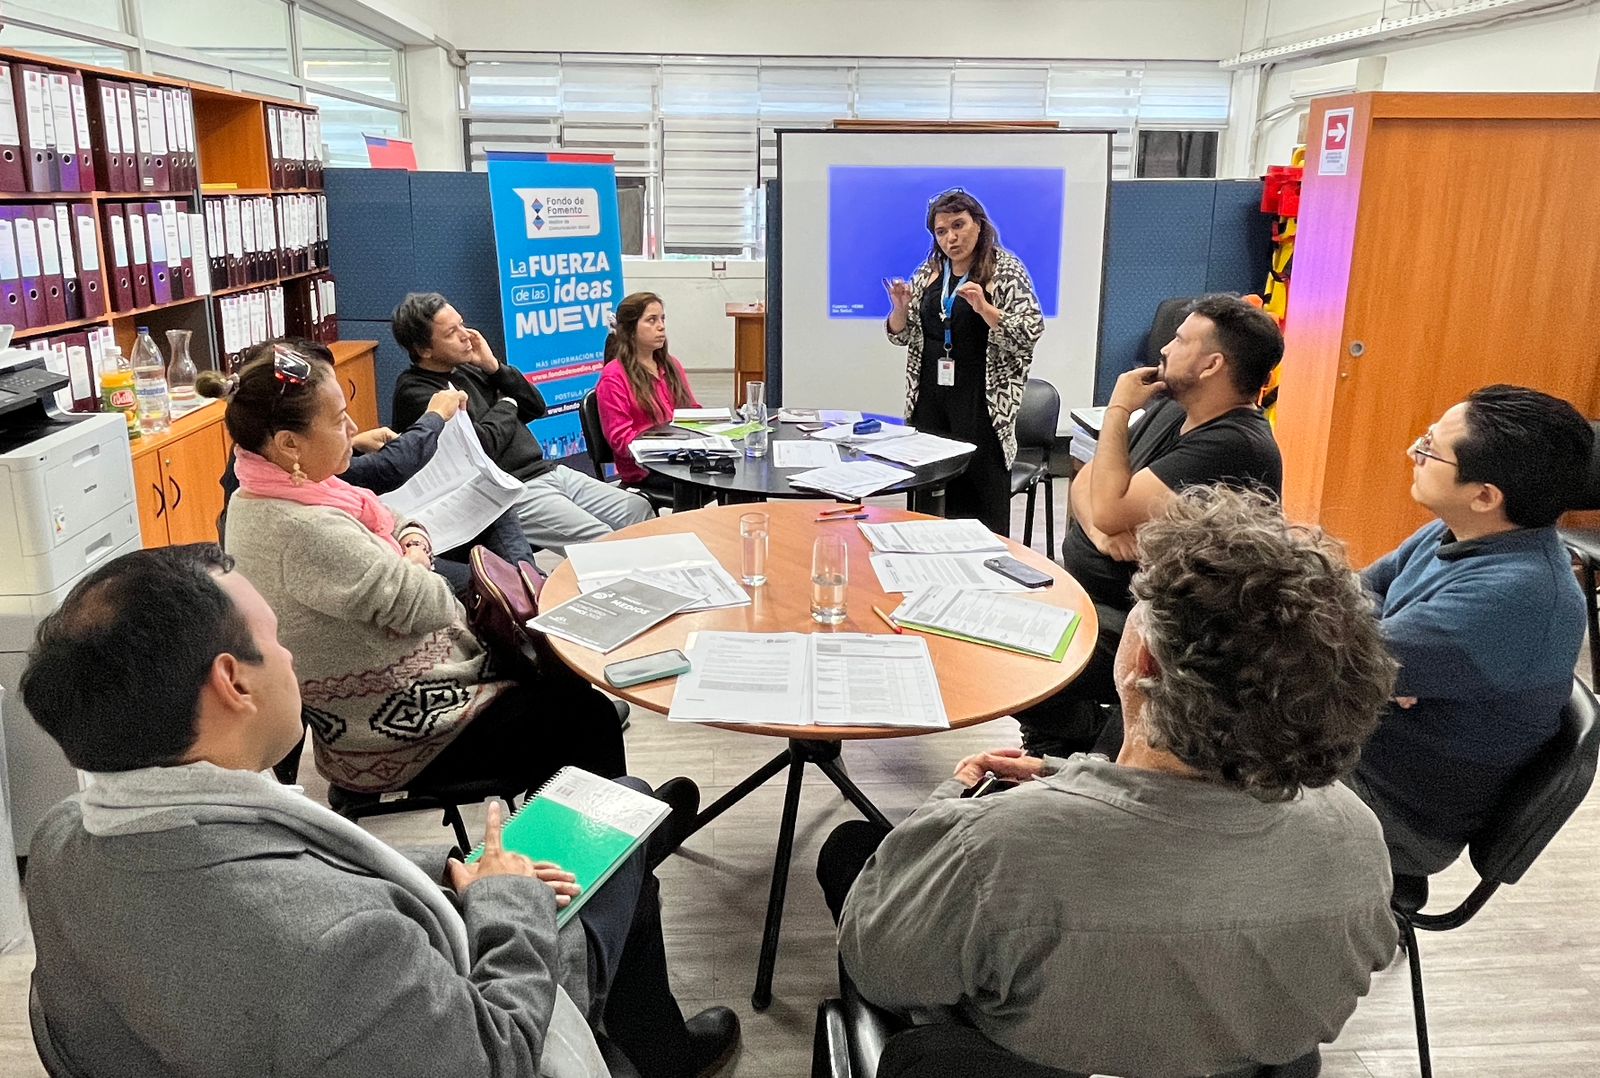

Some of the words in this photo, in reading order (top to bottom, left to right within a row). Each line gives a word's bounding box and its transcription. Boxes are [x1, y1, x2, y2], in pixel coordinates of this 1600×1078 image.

[546, 196, 572, 206] Fondo
[574, 196, 584, 205] de
[547, 205, 583, 215] Fomento
[510, 258, 528, 275] La
[528, 251, 610, 278] FUERZA
[515, 290, 529, 302] de
[532, 289, 545, 300] las
[553, 277, 612, 304] ideas
[550, 352, 595, 366] INFORMACIÓN
[554, 389, 583, 401] POSTULA
[610, 599, 651, 616] MEDIOS
